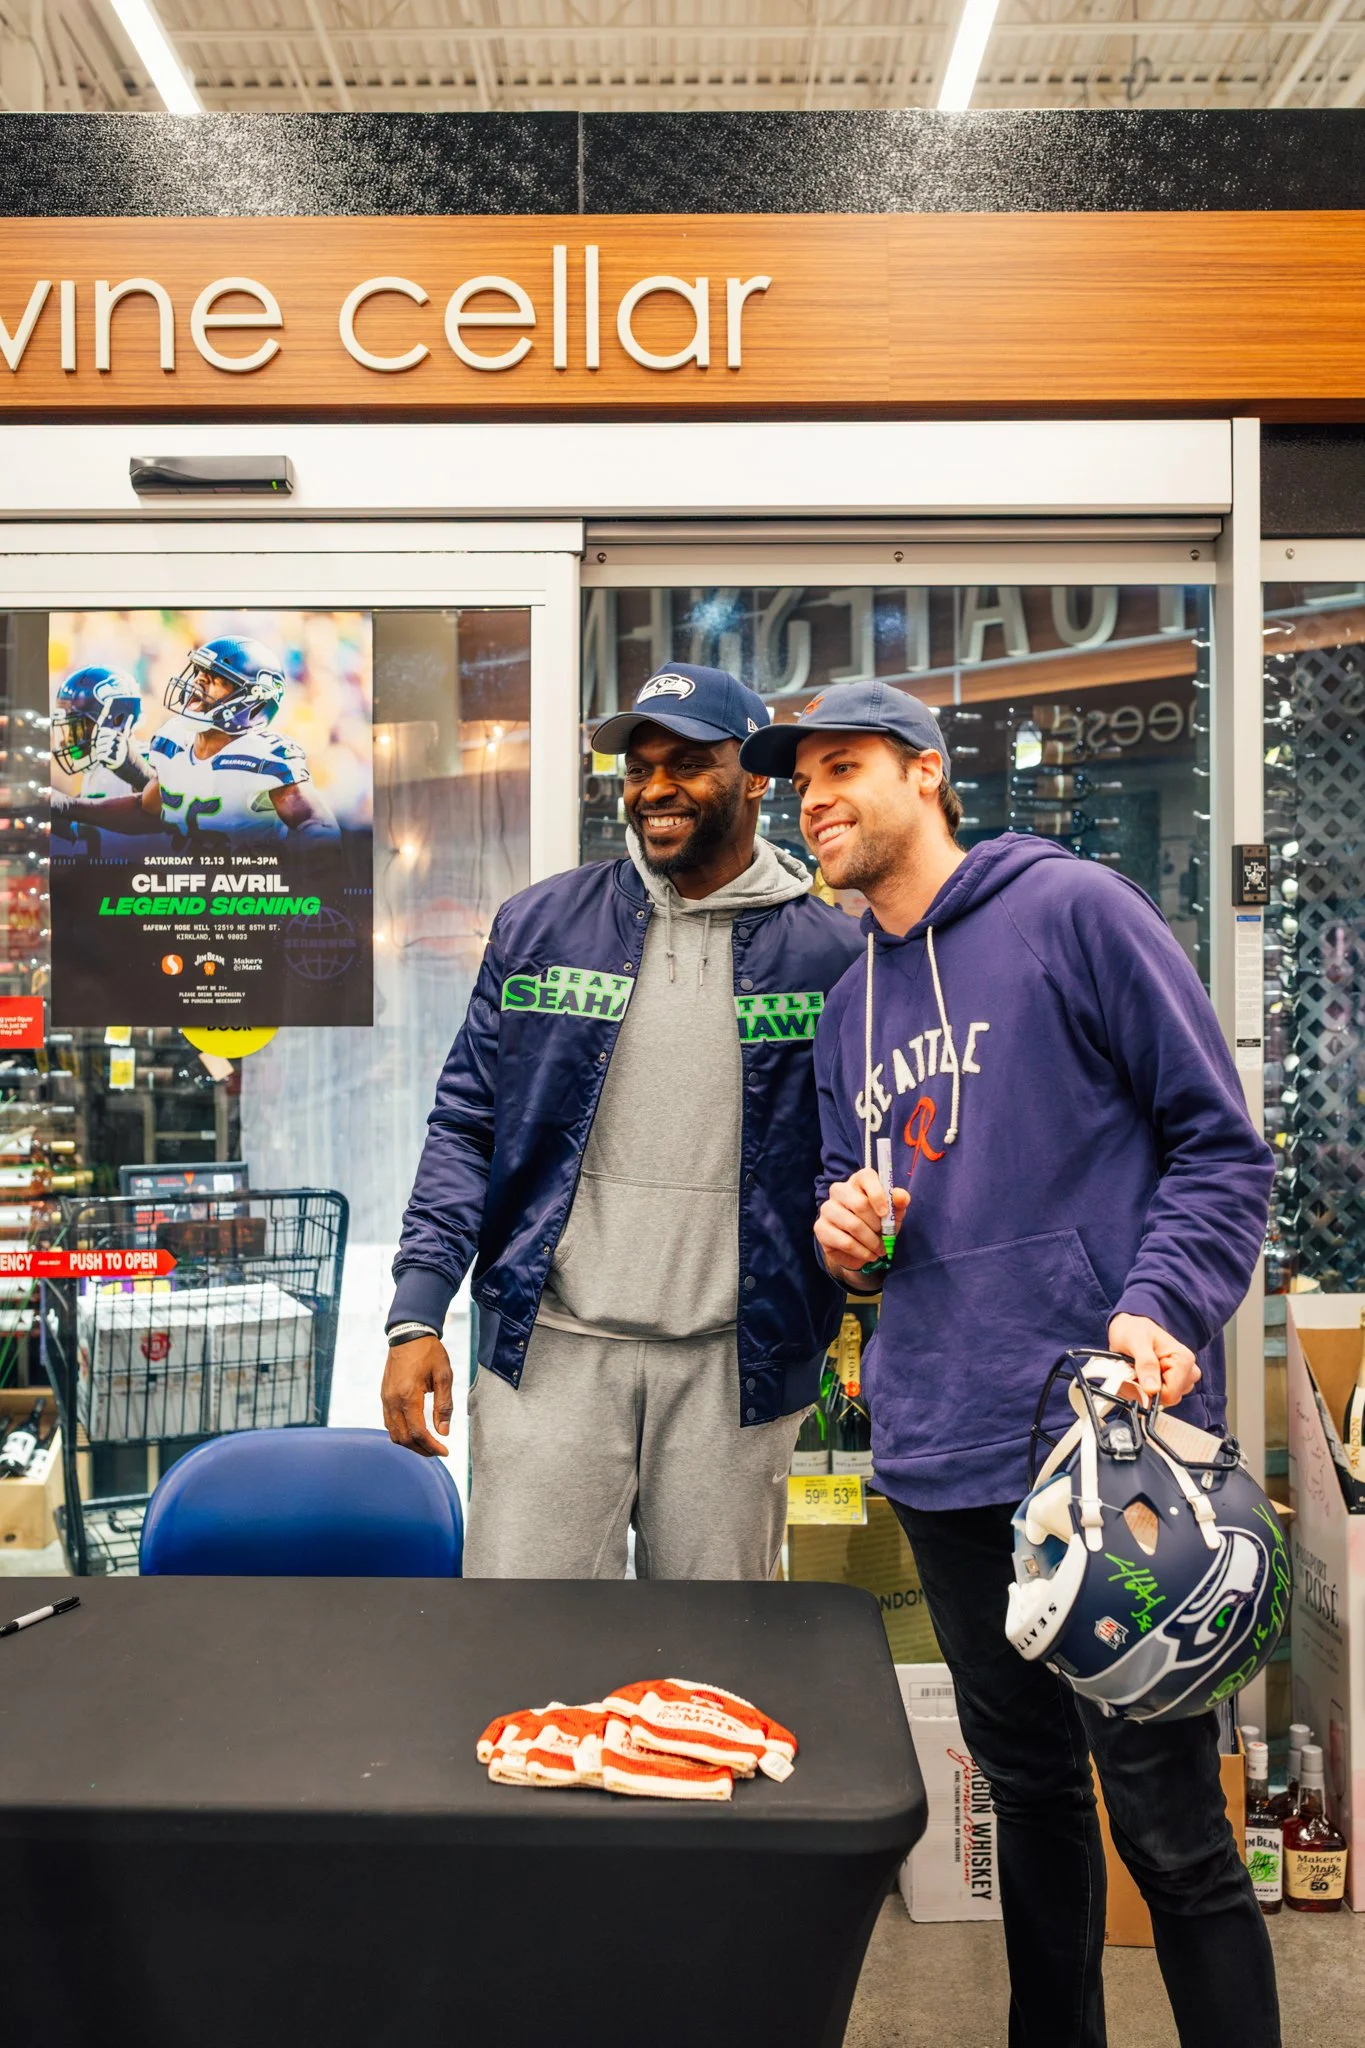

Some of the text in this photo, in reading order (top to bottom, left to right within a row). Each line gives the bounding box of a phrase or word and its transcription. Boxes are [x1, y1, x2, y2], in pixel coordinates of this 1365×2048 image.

[338, 244, 773, 372] cellar
[143, 856, 194, 866] SATURDAY
[199, 856, 225, 866] 12.13
[131, 873, 290, 893] CLIFF AVRIL
[98, 896, 322, 916] LEGEND SIGNING
[176, 933, 211, 941] KIRKLAND,
[549, 970, 627, 991] SEAT
[738, 995, 821, 1011] TTLE
[855, 1022, 990, 1133] SEATTLE
[69, 1252, 103, 1271] PUSH
[105, 1252, 122, 1270] TO
[124, 1251, 158, 1270] OPEN
[1256, 1835, 1280, 1853] BEAM
[971, 1822, 992, 1900] WHISKEY
[1297, 1854, 1342, 1863] Maker's
